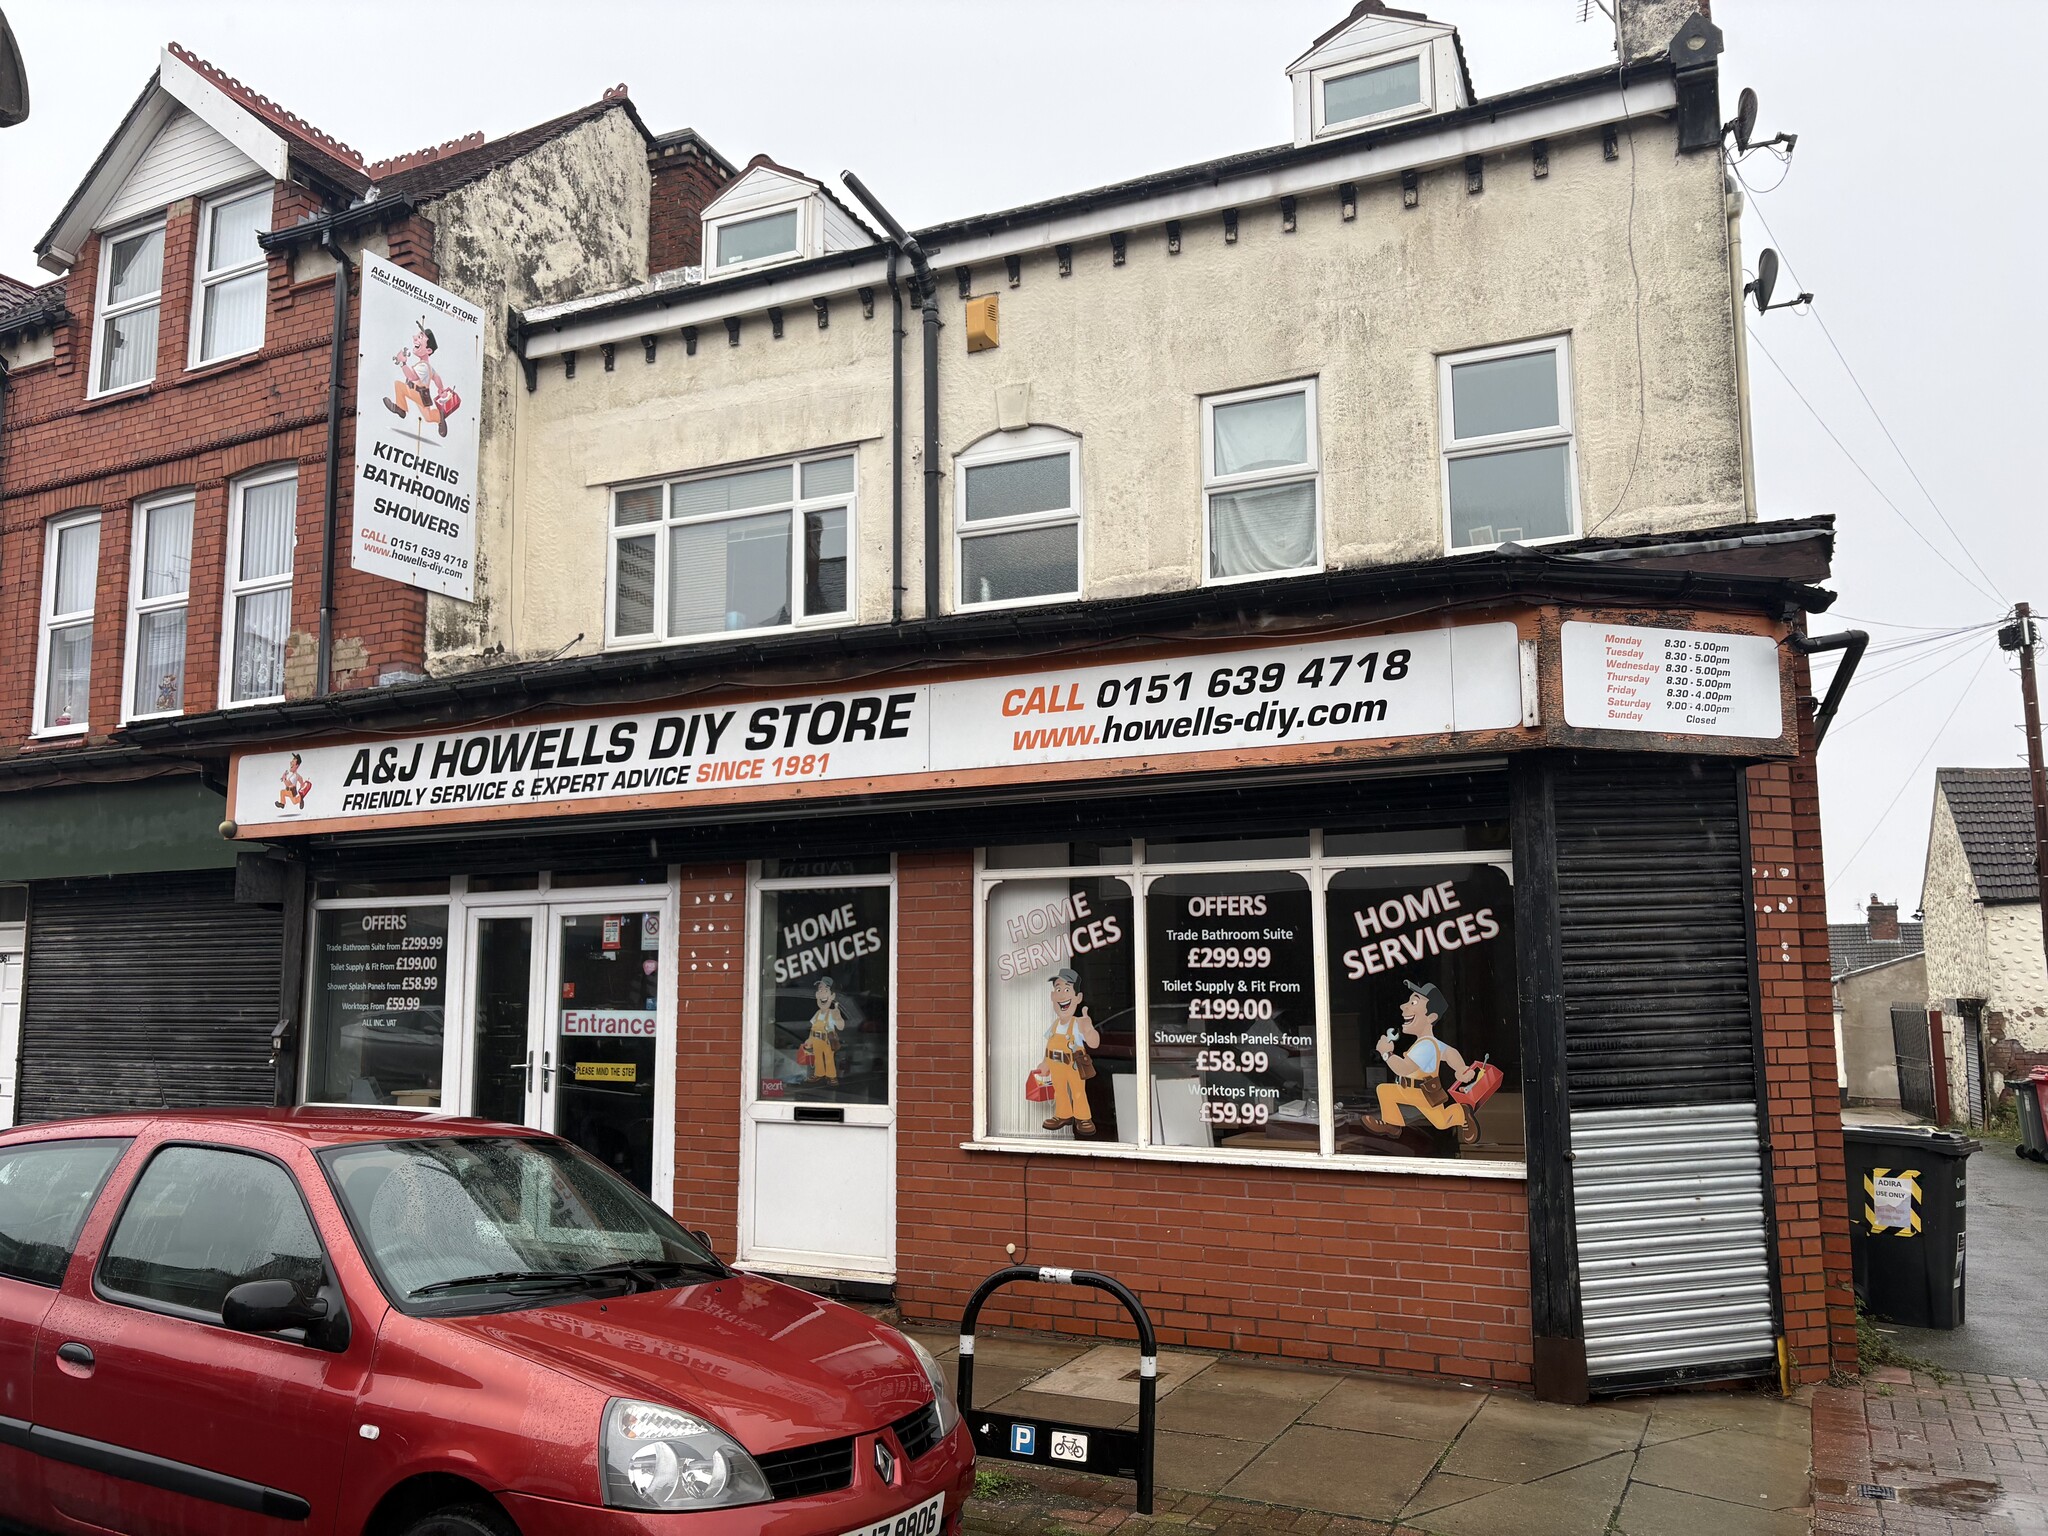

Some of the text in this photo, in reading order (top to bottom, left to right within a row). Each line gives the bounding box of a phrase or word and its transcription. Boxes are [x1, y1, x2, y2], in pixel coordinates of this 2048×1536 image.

[371, 267, 478, 324] A&J HOWELLS DIY STORE
[373, 441, 459, 485] KITCHENS
[363, 464, 470, 514] BATHROOMS
[374, 498, 459, 538] SHOWERS
[361, 528, 468, 569] CALL 0151 639 4718
[364, 543, 462, 579] www.howells-diy.com
[1605, 634, 1642, 647] Monday
[1664, 639, 1686, 649] 8.30
[1694, 641, 1729, 652] 5.00pm
[1605, 647, 1644, 660] Tuesday
[1665, 651, 1687, 661] 8.30
[1695, 654, 1730, 665] 5.00pm
[1606, 659, 1660, 673] Wednesday
[1666, 664, 1688, 673] 8.30
[1696, 666, 1730, 677] 5.00pm
[1001, 649, 1411, 718] CALL 0151 639 4718
[1607, 672, 1650, 686] Thursday
[1666, 676, 1688, 686] 8.30
[1696, 678, 1731, 689] 5.00pm
[1607, 685, 1636, 697] Friday
[1667, 689, 1688, 698] 8.30
[1607, 697, 1651, 710] Saturday
[1666, 701, 1687, 711] 9.00
[1013, 696, 1388, 751] www.howells-diy.com
[1608, 710, 1716, 725] Sunday Closed
[343, 692, 916, 788] A&J HOWELLS DIY STORE
[342, 753, 830, 812] FRIENDLY SERVICE & EXPERT ADVICE SINCE 1981
[1188, 895, 1267, 917] OFFERS
[1354, 880, 1461, 938] HOME
[362, 915, 406, 930] OFFERS
[783, 903, 857, 948] HOME
[1007, 891, 1091, 943] HOME
[343, 943, 370, 951] Bathroom
[402, 936, 443, 950] £299.99
[1166, 928, 1293, 941] Trade Bathroom Suite
[1343, 908, 1499, 979] SERVICES
[773, 928, 881, 983] SERVICES
[998, 916, 1121, 980] SERVICES
[1187, 947, 1271, 968] £299.99
[346, 963, 364, 972] Supply
[396, 957, 437, 970] £199.00
[349, 982, 366, 991] Splash
[368, 982, 385, 990] Panels
[402, 977, 437, 990] £58.99
[1162, 980, 1300, 994] Toilet Supply & Fit From
[342, 1003, 369, 1011] Worktops
[386, 997, 420, 1010] £59.99
[1189, 998, 1272, 1020] £199.00
[565, 1013, 656, 1034] Entrance
[1154, 1032, 1312, 1046] Shower Splash Panels from
[576, 1067, 634, 1076] PLEASE MIND THE STEP
[1196, 1051, 1268, 1072] £58.99
[762, 1081, 783, 1091] heart
[1189, 1084, 1279, 1099] Worktops From
[1199, 1102, 1268, 1125] £59.99
[1016, 1427, 1031, 1450] P
